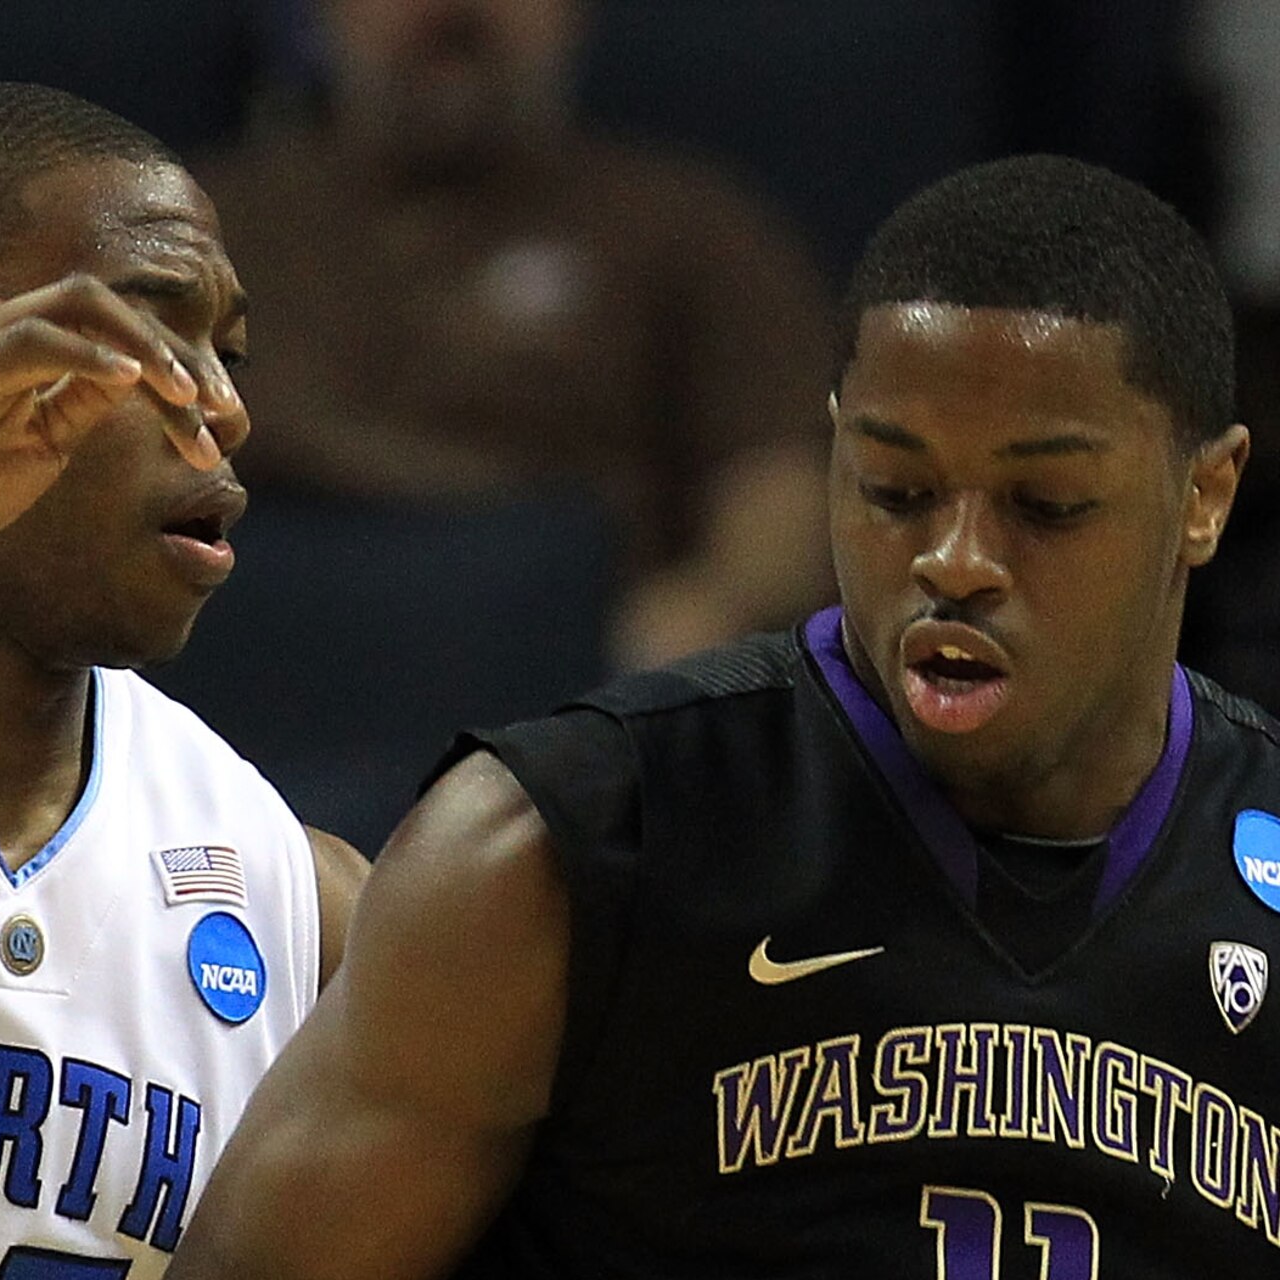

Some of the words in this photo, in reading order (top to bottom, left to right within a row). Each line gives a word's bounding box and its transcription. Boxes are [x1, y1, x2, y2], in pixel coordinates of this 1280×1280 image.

[200, 963, 258, 997] NCAA
[1213, 945, 1266, 1003] PAC
[1223, 978, 1255, 1015] 10
